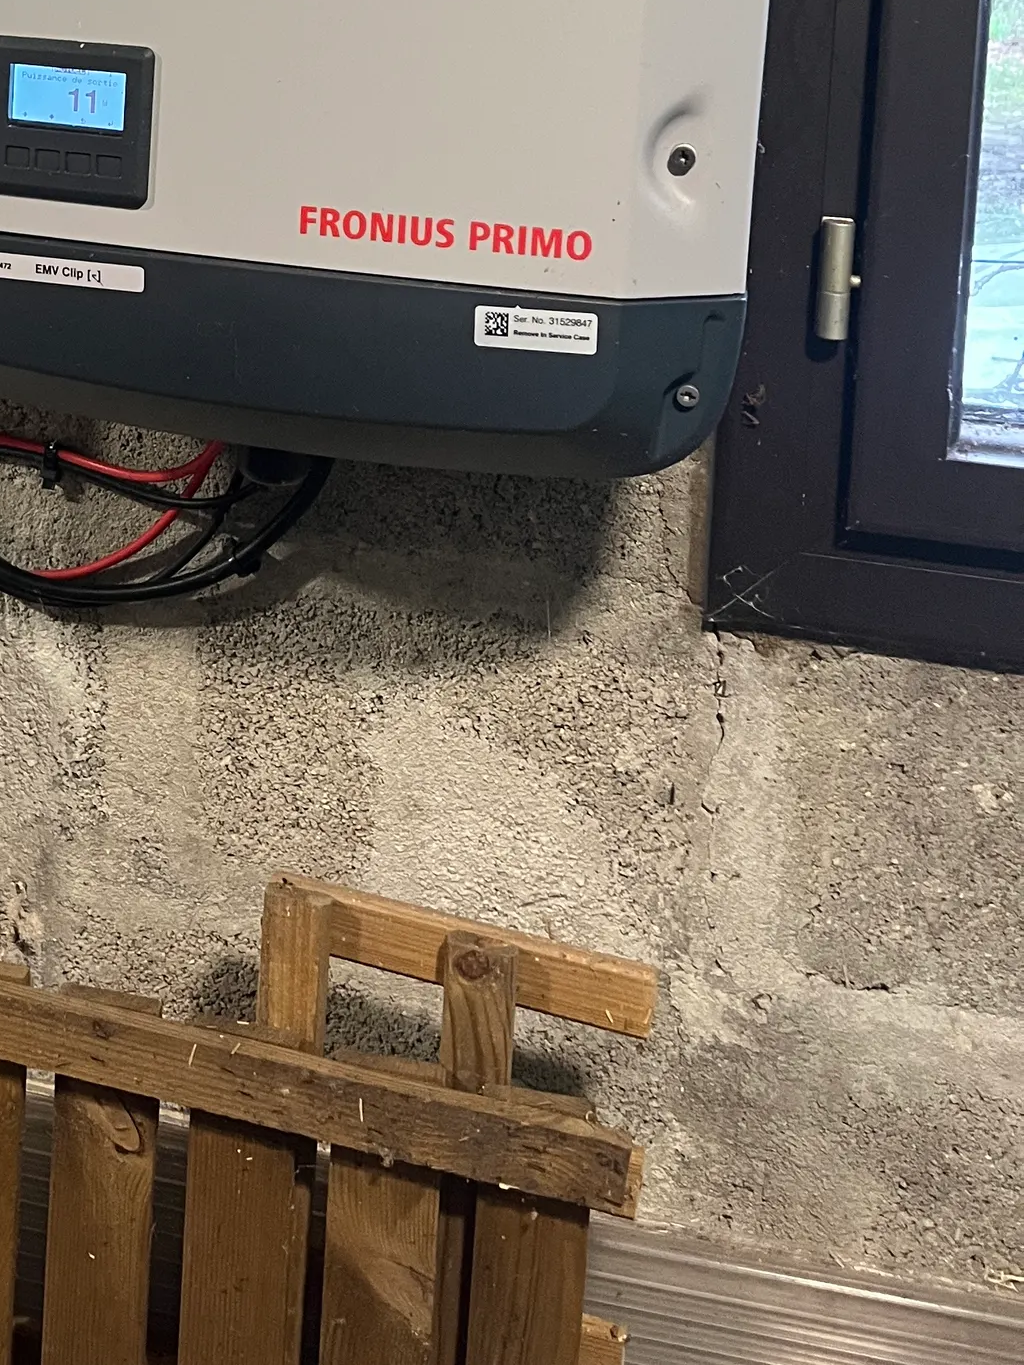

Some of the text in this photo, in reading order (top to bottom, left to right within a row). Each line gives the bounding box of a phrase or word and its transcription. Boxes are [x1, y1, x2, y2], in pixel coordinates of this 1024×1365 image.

[72, 75, 82, 84] de
[87, 78, 118, 87] sortie
[68, 87, 96, 114] 11
[299, 205, 593, 262] FRONIUS PRIMO
[35, 263, 59, 276] EMV
[62, 266, 84, 280] Clip
[514, 314, 593, 327] Ser. No. 31529847
[513, 329, 538, 338] Remove
[548, 332, 572, 340] Service
